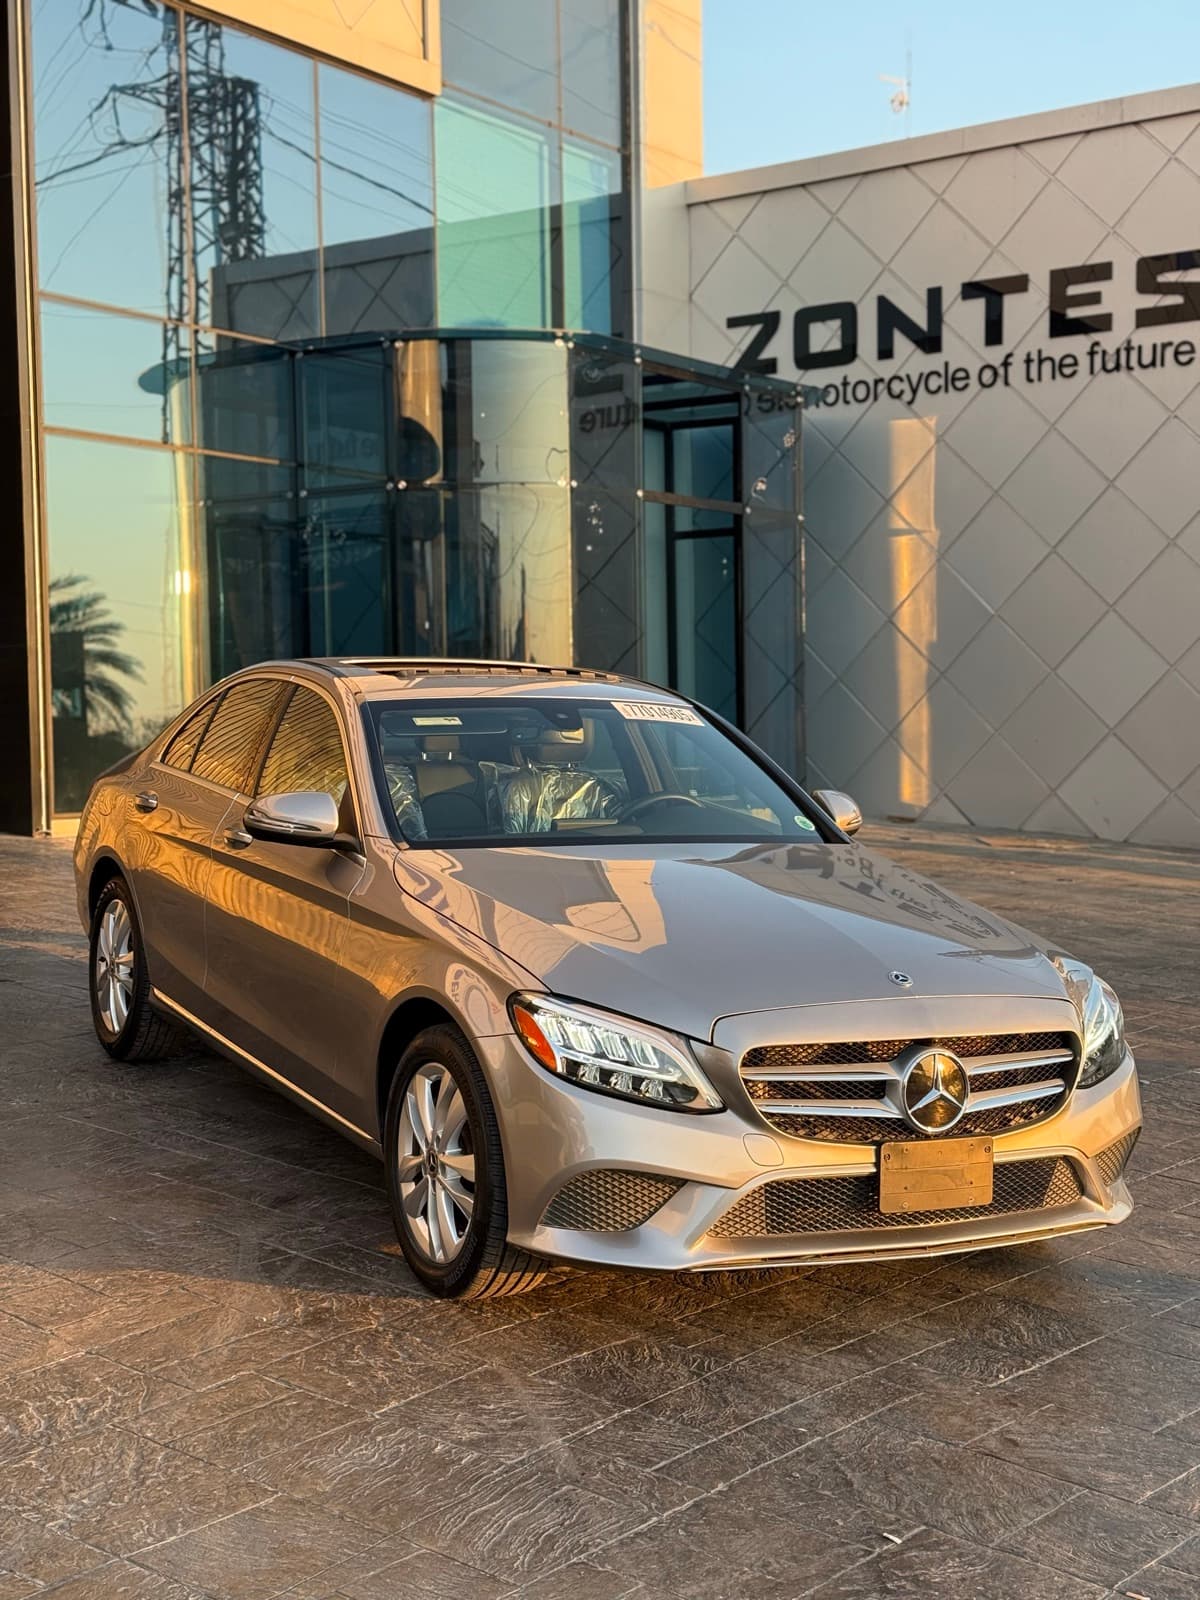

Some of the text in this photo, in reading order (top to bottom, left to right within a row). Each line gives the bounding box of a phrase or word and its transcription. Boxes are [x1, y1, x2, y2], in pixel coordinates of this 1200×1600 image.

[726, 249, 1200, 378] ZONTES
[977, 353, 1014, 389] of
[1023, 348, 1079, 383] the
[1086, 337, 1196, 375] future
